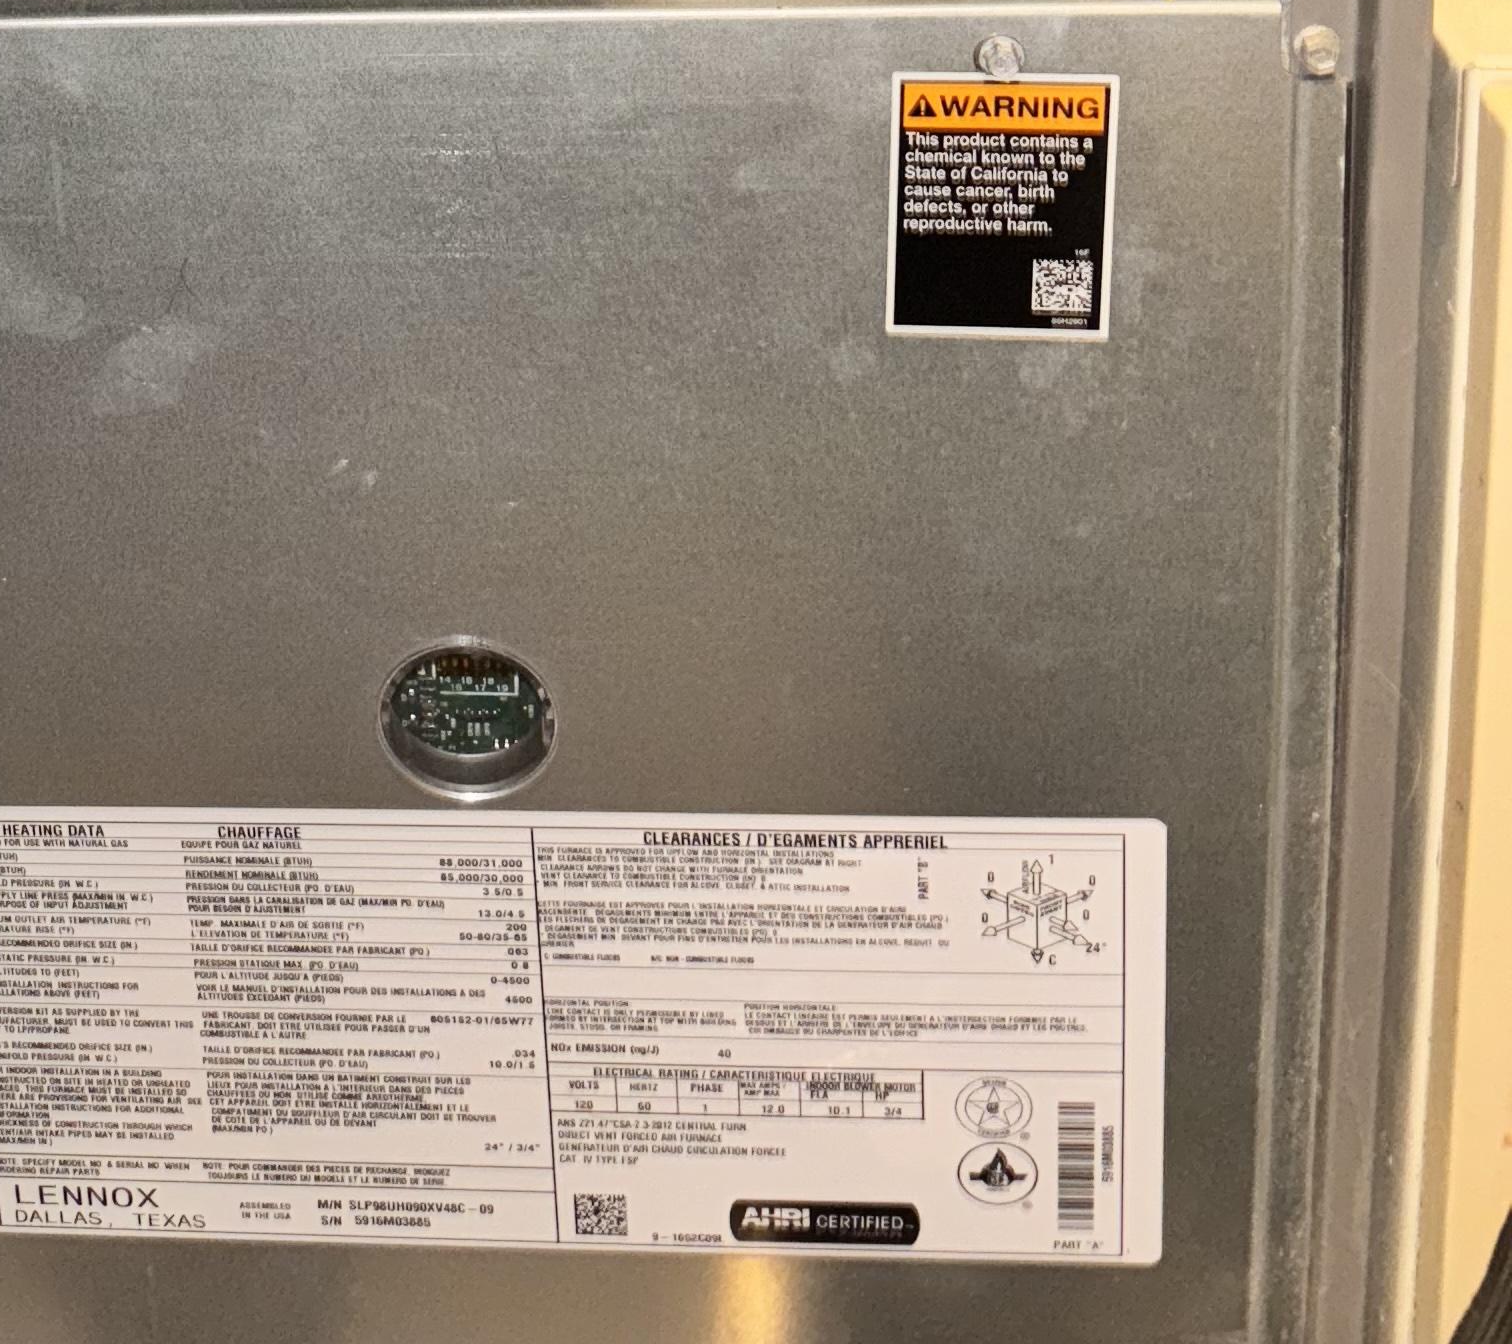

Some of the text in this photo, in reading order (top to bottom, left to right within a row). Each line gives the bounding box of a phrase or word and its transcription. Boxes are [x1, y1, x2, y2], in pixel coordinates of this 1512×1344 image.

[939, 95, 1099, 119] WARNING
[905, 131, 939, 147] This
[943, 132, 1006, 150] product
[1009, 133, 1078, 149] contains
[905, 148, 1086, 166] chemical known to the
[904, 166, 1069, 182] State of California to
[904, 184, 1055, 199] cause cancer, birth
[903, 199, 1035, 215] defects, or other
[903, 216, 1053, 233] reproductive harm.
[2, 824, 105, 837] HEATING DATA
[218, 826, 301, 839] CHAUFFAGE
[643, 832, 740, 847] CLEARANCES
[757, 833, 857, 848] D'EGAMENTS
[863, 835, 948, 849] APPRERIEL
[575, 1043, 626, 1054] EMISSION
[593, 1067, 876, 1083] ELECTRICAL RATING CARACTERISTIQUE ELECTRIQUE
[568, 1080, 723, 1094] VOLTS PHASE
[15, 1184, 159, 1208] LENNOX
[318, 1199, 342, 1210] M/N
[15, 1209, 206, 1228] DALLAS, TEXAS
[321, 1216, 342, 1226] S/N
[742, 1206, 904, 1230] AHRI CERTIFIED
[1054, 1240, 1081, 1249] PART
